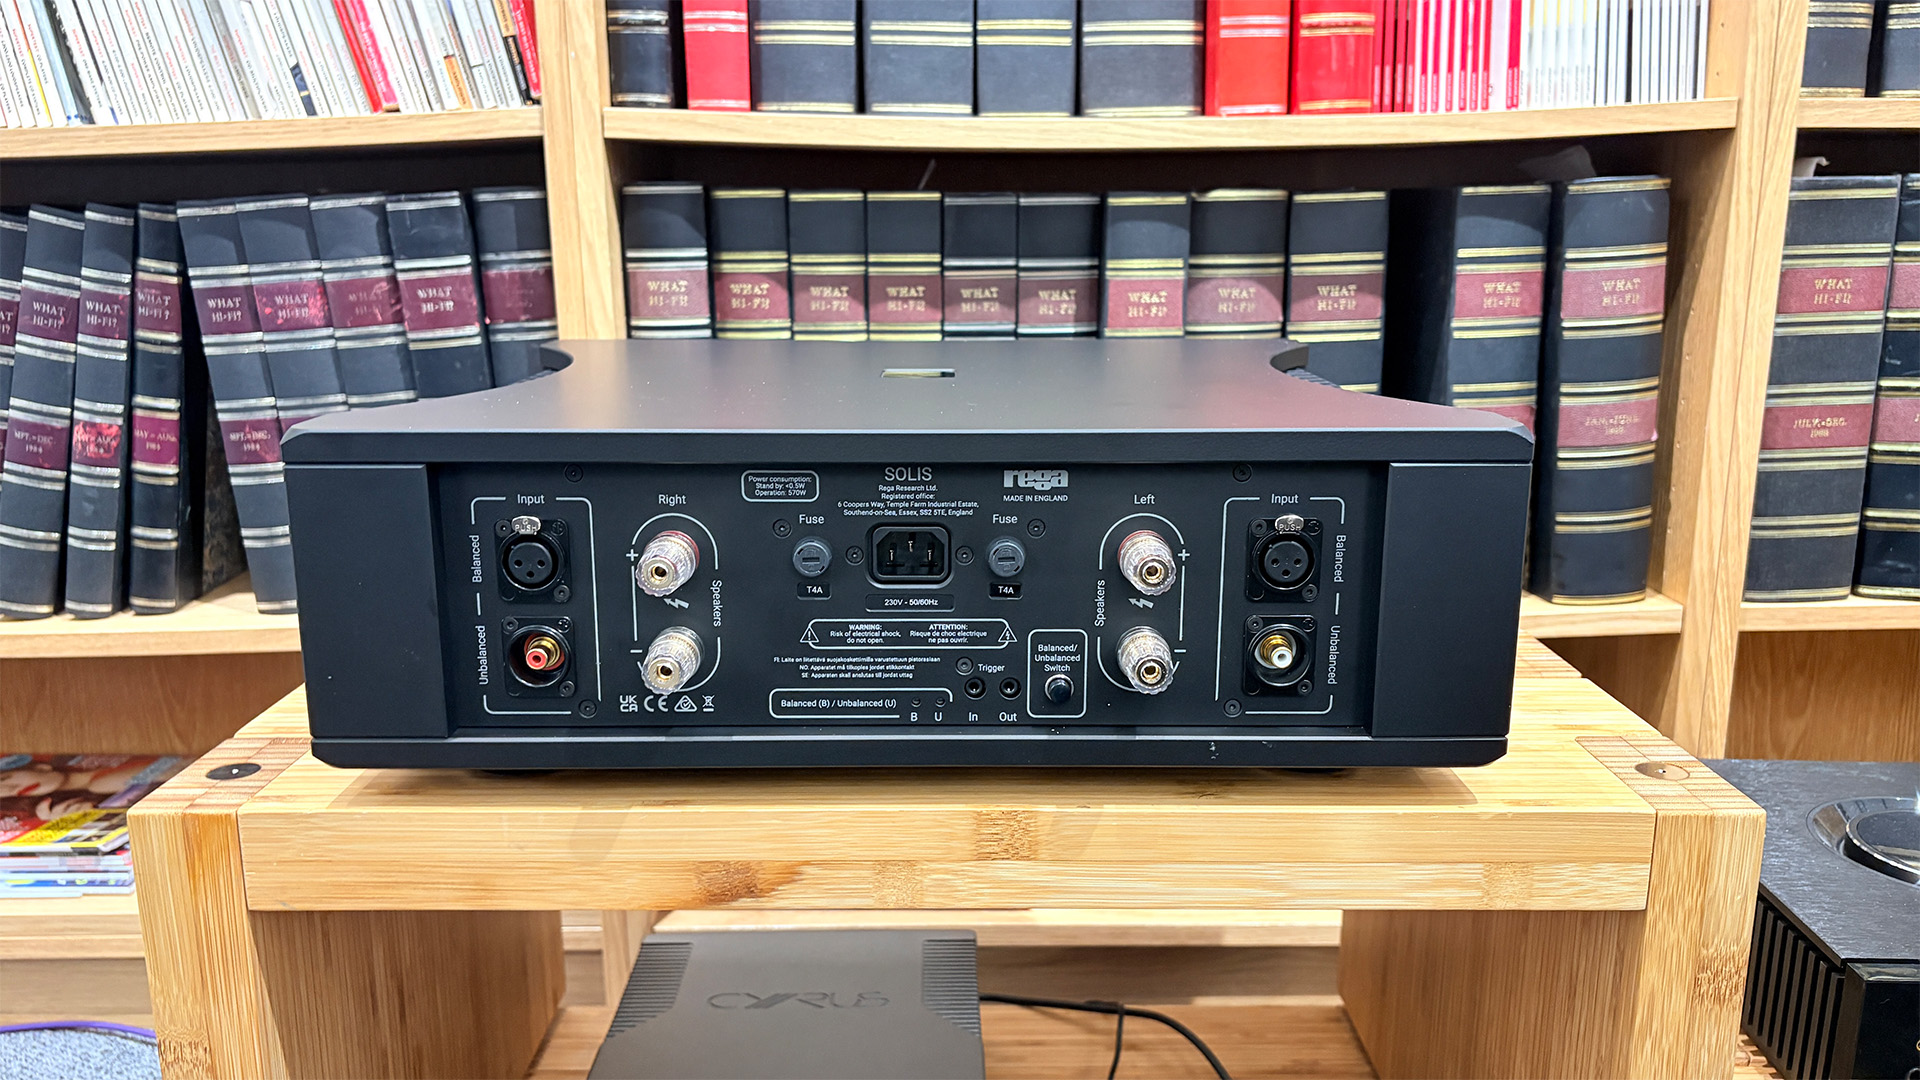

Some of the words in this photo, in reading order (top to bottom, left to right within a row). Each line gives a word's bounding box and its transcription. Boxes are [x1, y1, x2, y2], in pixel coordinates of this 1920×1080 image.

[647, 280, 688, 292] WHAT
[730, 283, 770, 295] WHAT
[1484, 281, 1521, 294] WHAT
[1602, 278, 1641, 292] WHAT
[1814, 278, 1853, 290] WHAT
[417, 286, 452, 299] WHAT
[809, 286, 849, 298] WHAT
[886, 286, 926, 298] WHAT
[960, 288, 999, 299] WHAT
[1038, 289, 1077, 300] WHAT
[1218, 288, 1256, 300] WHAT
[1317, 285, 1356, 297] WHAT
[138, 292, 171, 306] WHAT
[207, 297, 241, 309] WHAT
[274, 294, 309, 306] WHAT
[1128, 291, 1167, 304] WHAT
[32, 301, 66, 316] WHAT
[86, 300, 120, 315] WHAT
[32, 315, 63, 329] HI-FI?
[87, 313, 118, 328] HI-FI?
[212, 310, 242, 322] HI-FI?
[884, 467, 932, 481] SOLIS
[1004, 470, 1069, 491] rega
[517, 494, 545, 506] Input
[658, 494, 686, 506] Right
[1134, 494, 1155, 505] Left
[1271, 493, 1299, 505] Input
[799, 514, 824, 524] Fuse
[992, 514, 1018, 524] Fuse
[469, 535, 482, 582] Balanced
[1334, 535, 1346, 583] Balanced
[806, 586, 823, 594] T4A
[998, 586, 1014, 594] T4A
[710, 580, 723, 627] Speakers
[1094, 580, 1106, 627] Speakers
[475, 625, 489, 685] Unbalanced
[1328, 625, 1341, 685] Unbalanced
[978, 664, 1005, 673] Trigger
[620, 695, 637, 703] UK
[781, 699, 816, 707] Balanced
[818, 699, 829, 709] (B)
[837, 699, 883, 707] Unbalanced
[885, 699, 896, 709] (U)
[910, 712, 918, 721] B
[934, 712, 942, 721] U
[968, 712, 978, 721] In
[999, 712, 1017, 721] Out
[706, 989, 890, 1010] CYRUS
